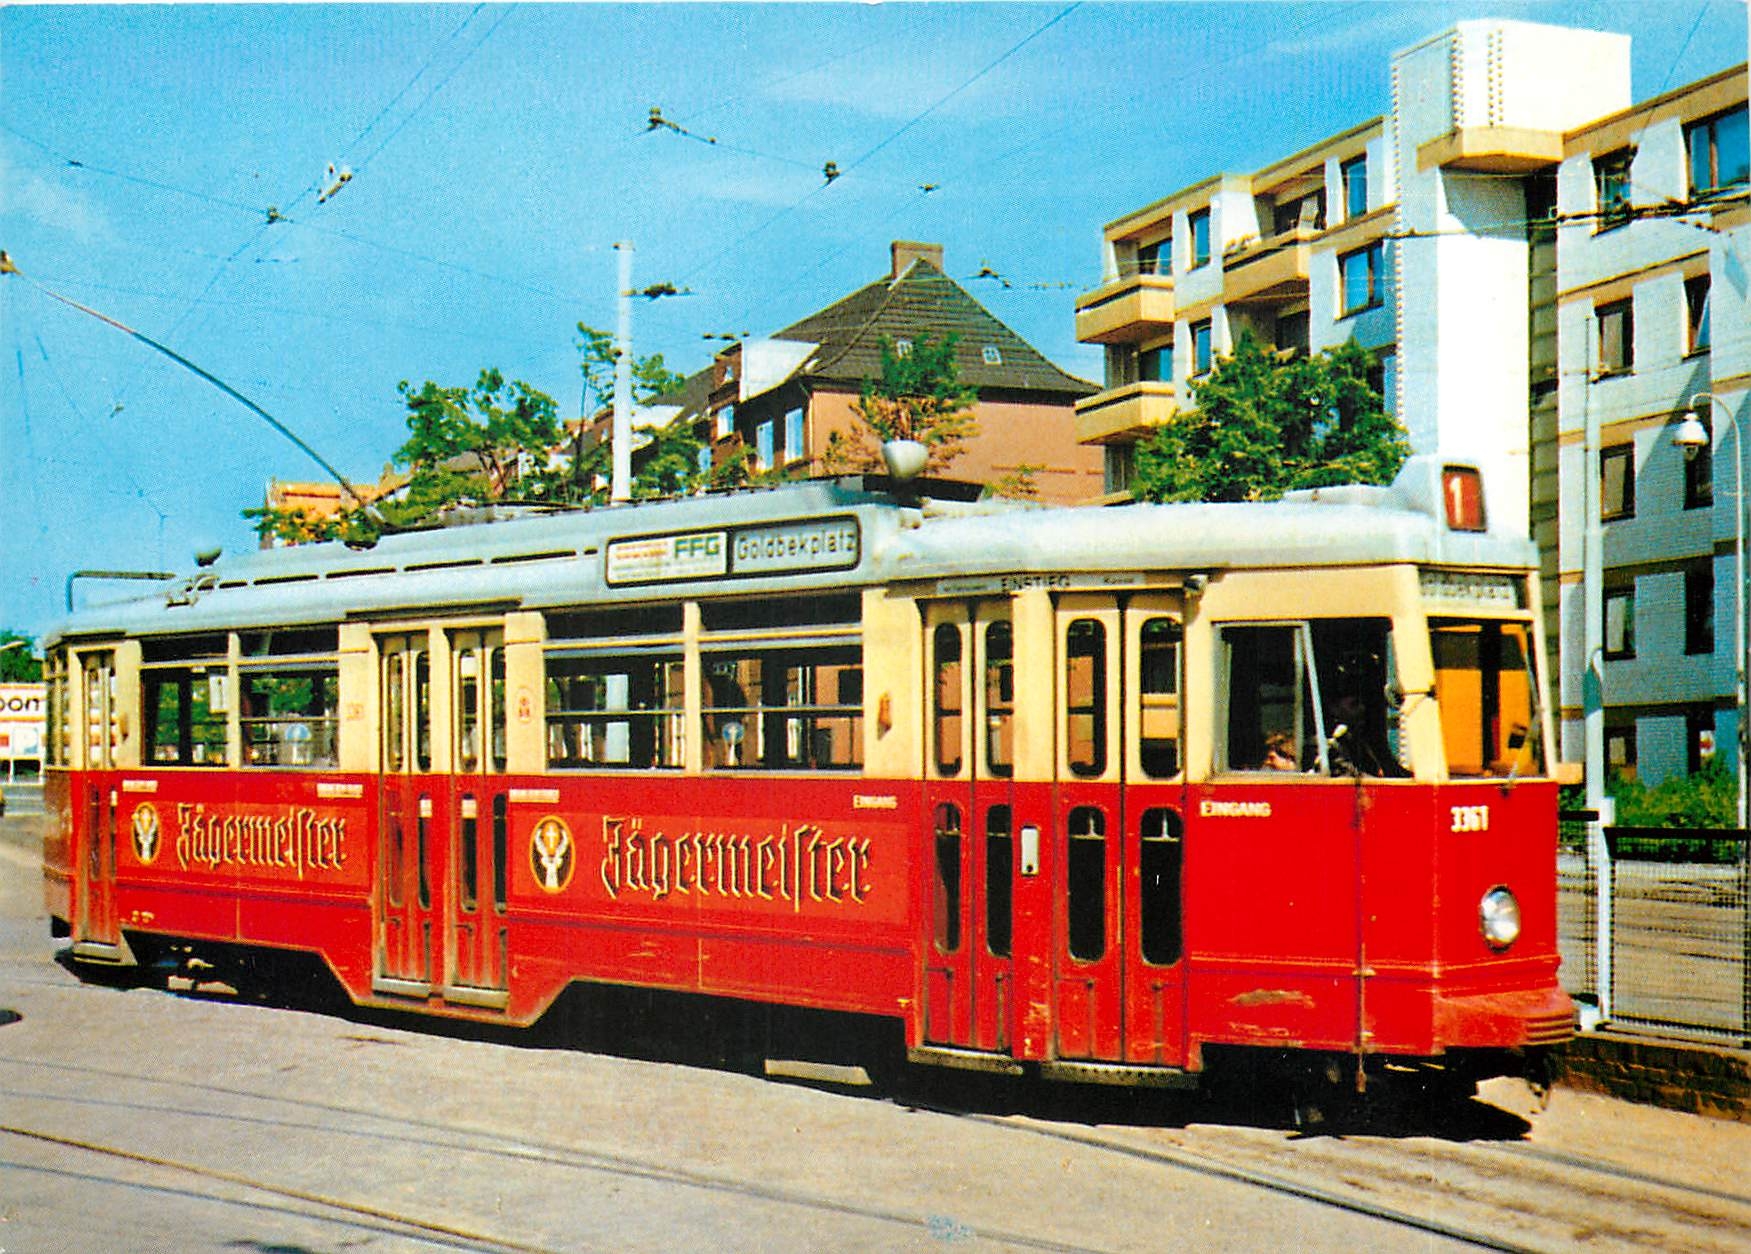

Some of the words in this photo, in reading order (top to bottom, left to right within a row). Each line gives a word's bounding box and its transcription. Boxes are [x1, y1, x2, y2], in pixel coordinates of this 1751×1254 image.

[1450, 476, 1463, 529] 1
[674, 535, 720, 559] FFG
[738, 528, 855, 560] Goldbekplatz
[1200, 801, 1272, 817] EINGANG
[1450, 805, 1489, 832] 3361
[601, 815, 872, 913] Jägermeister
